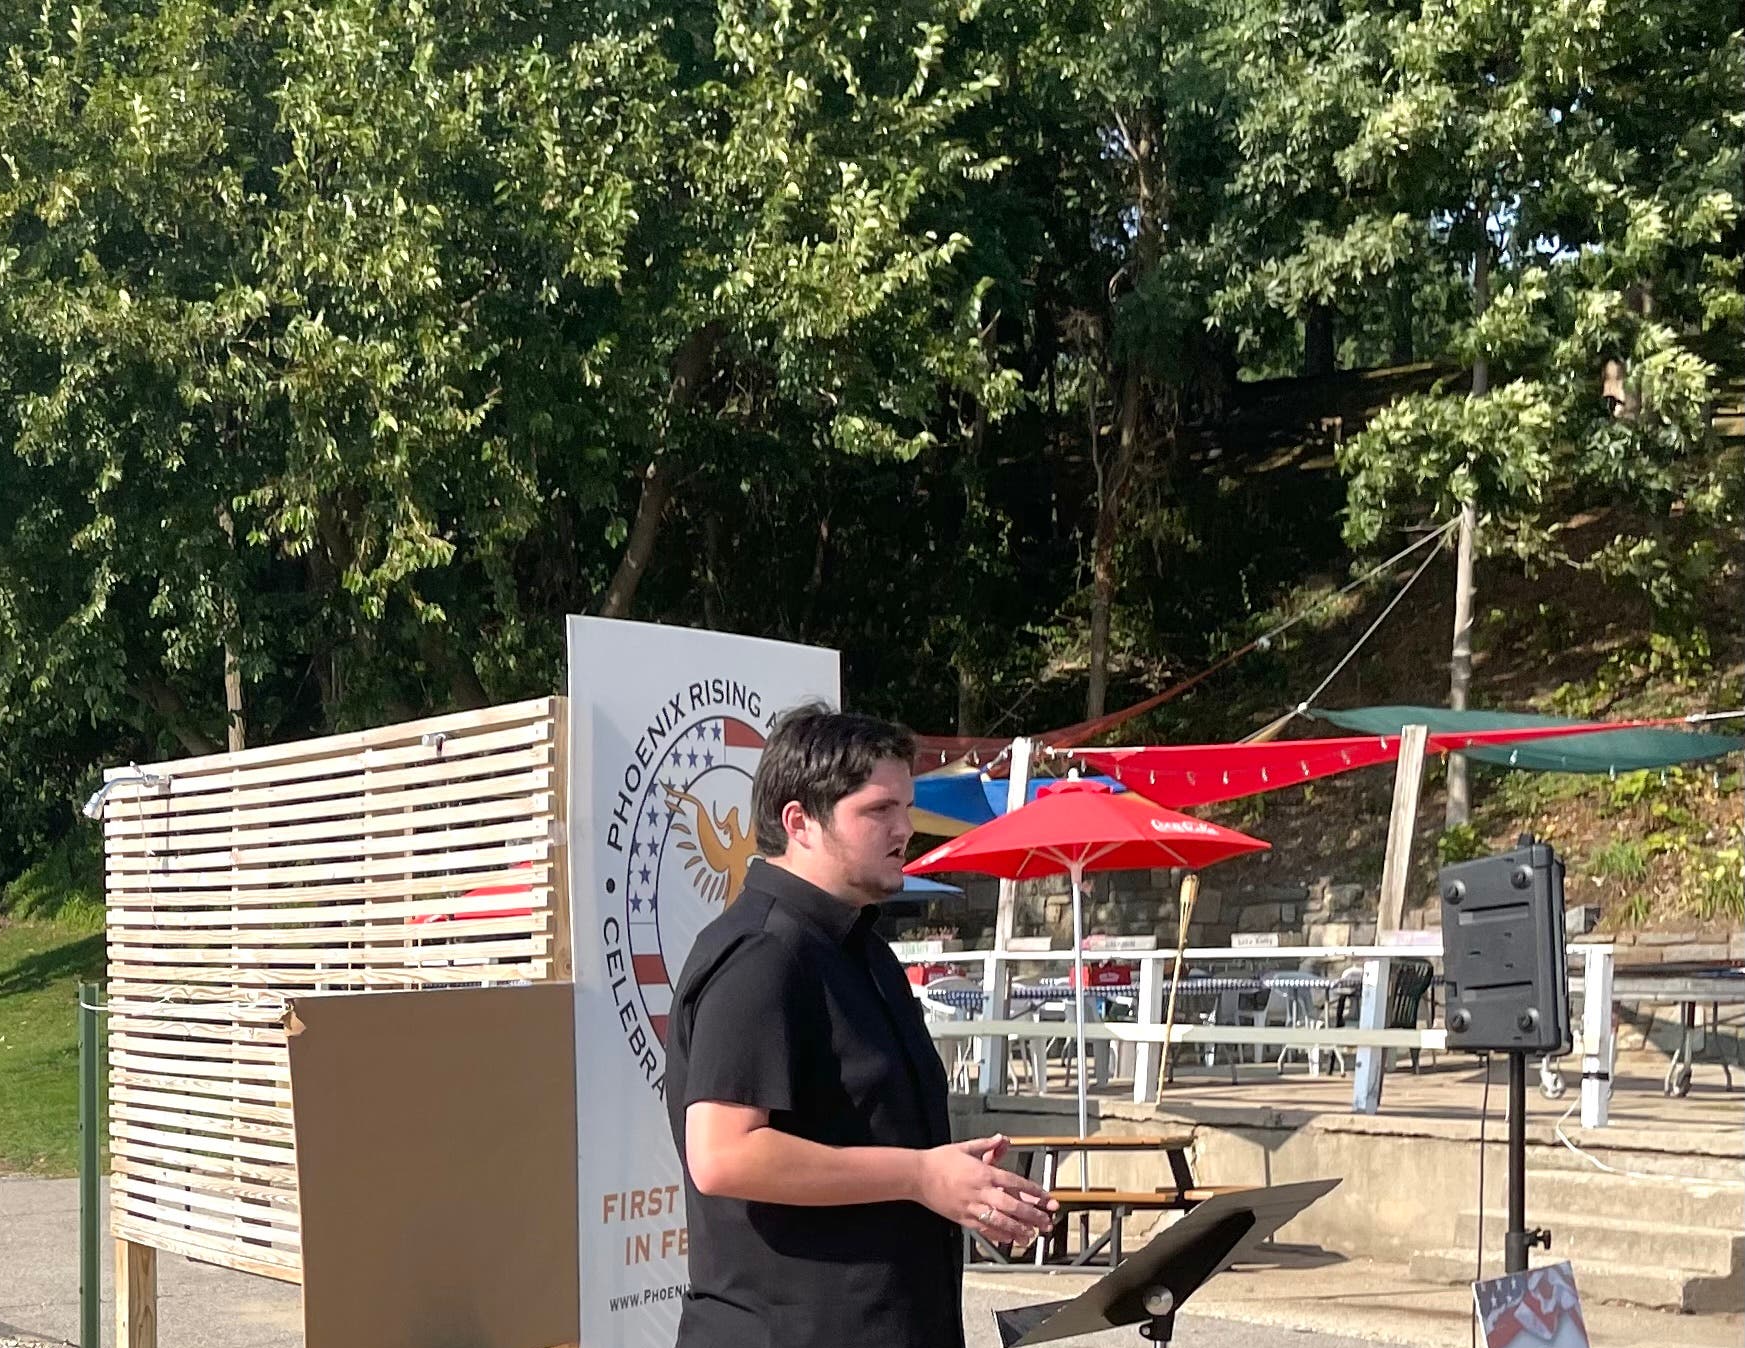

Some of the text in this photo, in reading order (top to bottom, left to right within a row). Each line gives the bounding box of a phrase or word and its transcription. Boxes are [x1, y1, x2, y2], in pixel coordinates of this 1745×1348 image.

[607, 692, 686, 851] PHOENIX
[689, 678, 762, 718] RISING
[602, 1184, 680, 1224] FIRST
[625, 1233, 651, 1266] IN
